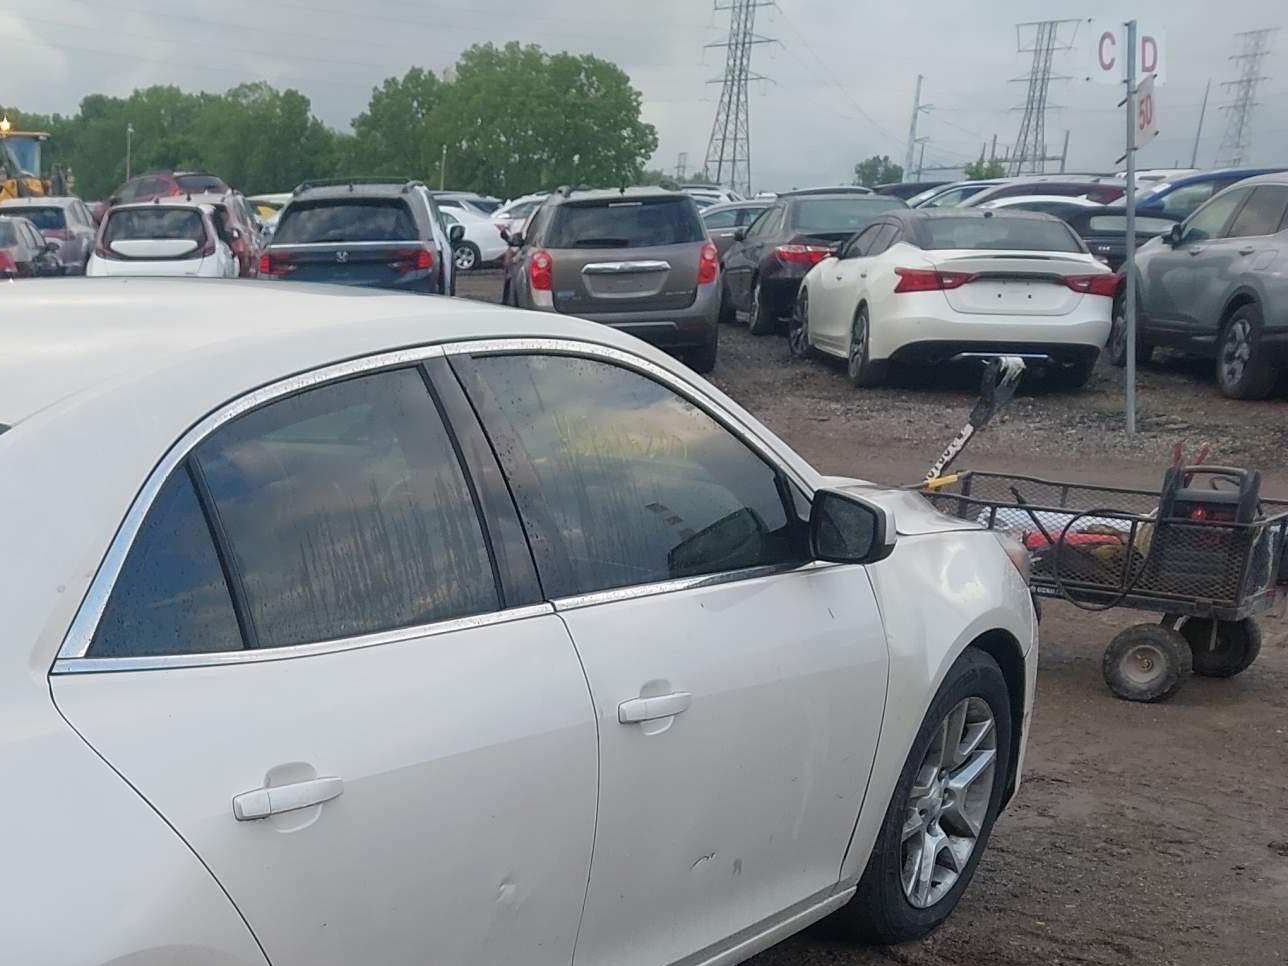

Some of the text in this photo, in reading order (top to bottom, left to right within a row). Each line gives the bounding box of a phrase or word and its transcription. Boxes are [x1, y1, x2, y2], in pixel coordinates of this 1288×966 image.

[1098, 31, 1116, 71] C
[1141, 35, 1158, 73] D
[1138, 93, 1153, 130] 50
